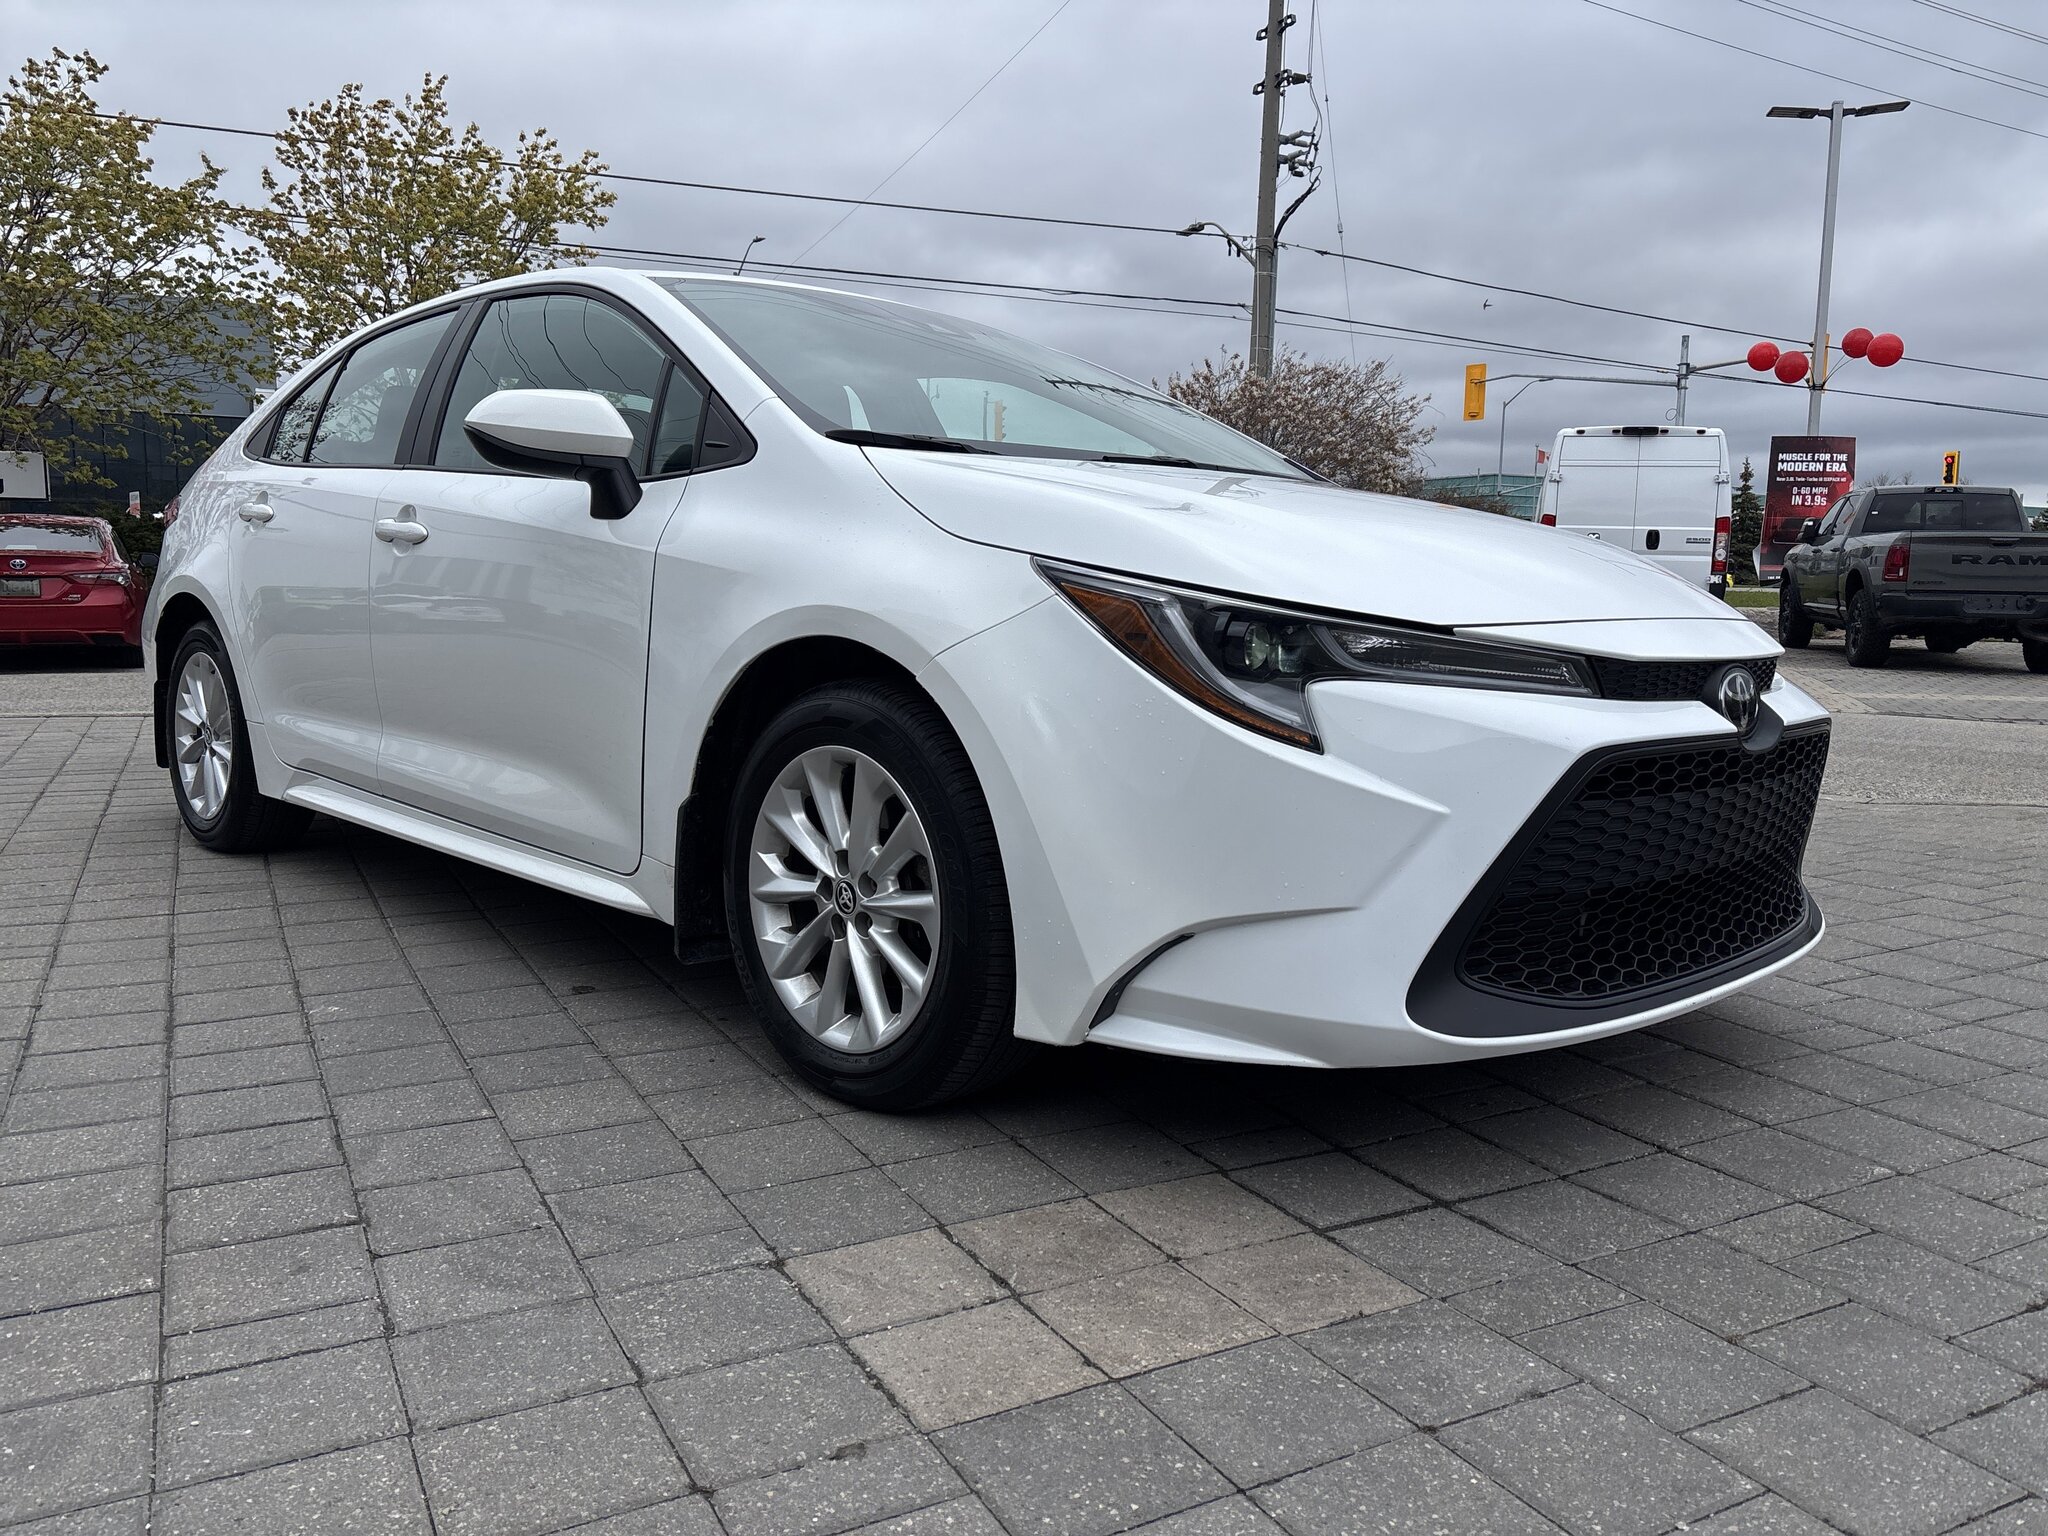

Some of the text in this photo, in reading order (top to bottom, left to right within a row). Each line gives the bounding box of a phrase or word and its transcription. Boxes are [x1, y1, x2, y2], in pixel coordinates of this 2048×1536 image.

[1778, 453, 1848, 462] MUSCLE FOR THE
[1777, 462, 1847, 472] MODERN ERA
[1792, 486, 1829, 495] 0-60 MPH
[1791, 495, 1827, 506] IN 3.9s
[1951, 554, 2048, 566] RAM
